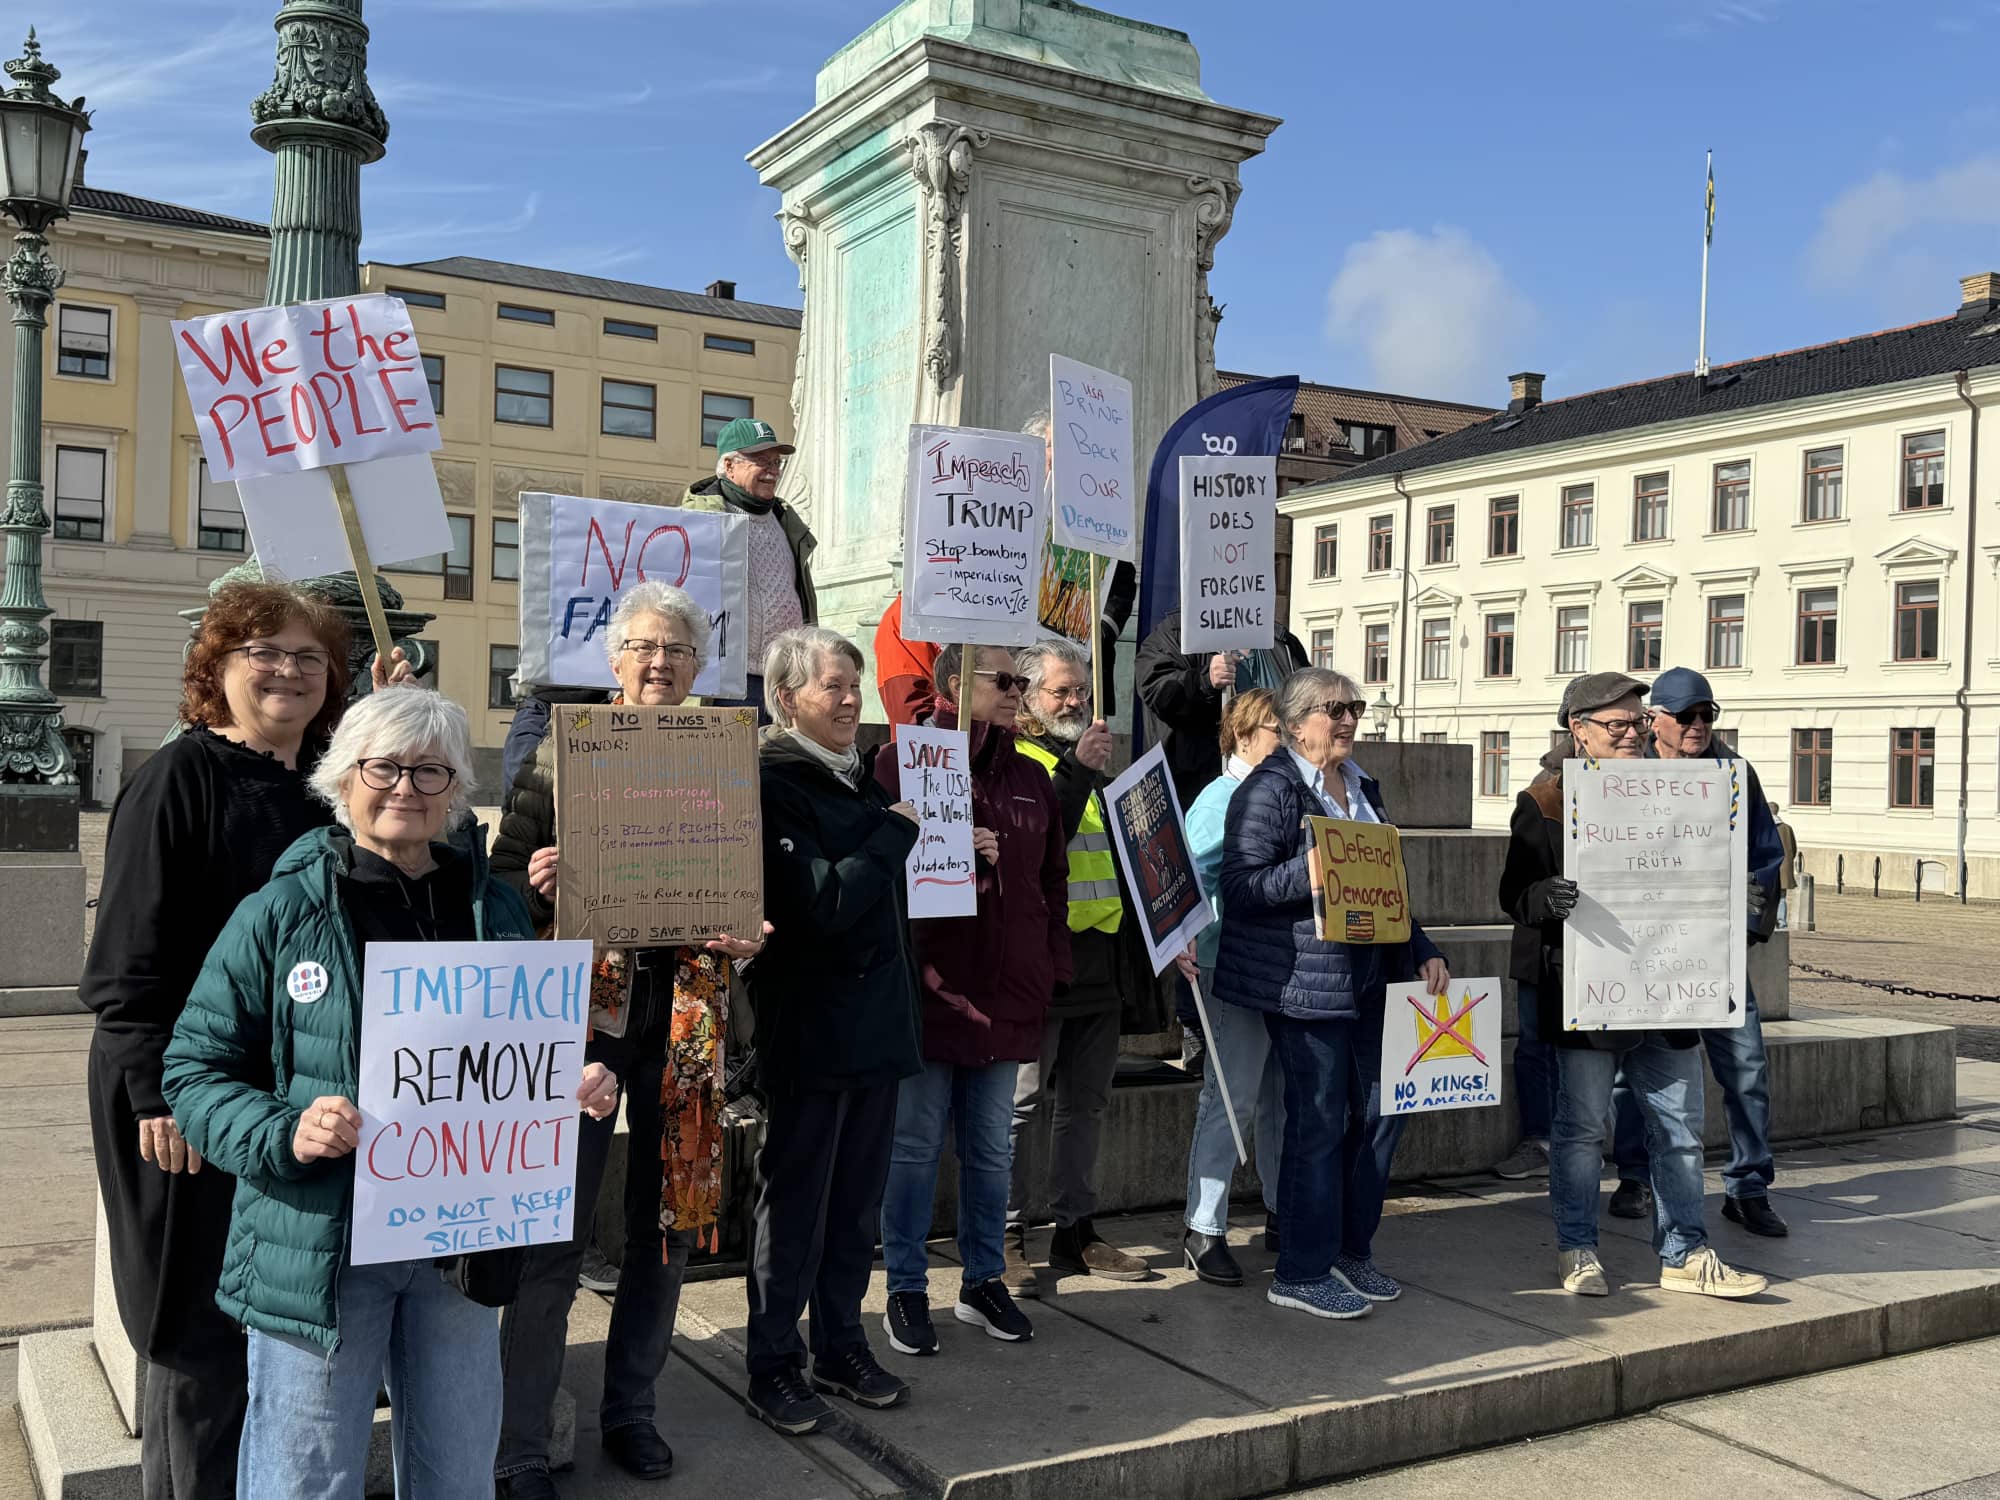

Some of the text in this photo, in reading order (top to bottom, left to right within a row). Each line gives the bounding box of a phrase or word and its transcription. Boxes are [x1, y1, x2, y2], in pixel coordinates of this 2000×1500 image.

[181, 304, 416, 387] We the
[1058, 380, 1124, 424] BRING
[1082, 382, 1105, 403] USA
[209, 368, 433, 470] PEOPLE
[1079, 473, 1121, 500] OUR
[1193, 473, 1266, 498] HISTORY
[935, 492, 1033, 532] TRUMP
[1210, 511, 1253, 529] DOES
[581, 517, 691, 592] NO
[925, 539, 967, 564] Stop
[1213, 542, 1248, 564] NOT
[1200, 574, 1265, 598] FORGIVE
[1199, 607, 1263, 630] SILENCE
[612, 712, 638, 725] NO
[569, 737, 629, 753] HONOR:
[904, 739, 958, 770] SAVE
[591, 788, 610, 800] US
[946, 773, 970, 798] USA
[1120, 769, 1160, 814] DEMOCRACY
[1603, 775, 1715, 800] RESPECT
[921, 801, 938, 820] the
[1124, 804, 1142, 825] DOES
[1151, 784, 1164, 803] FEAR
[1640, 803, 1672, 816] the
[590, 824, 609, 836] US
[620, 823, 655, 836] BILL
[679, 822, 726, 834] RIGHTS
[1127, 795, 1168, 841] PROTESTS
[920, 827, 946, 856] from
[1586, 823, 1712, 843] RULE of LAW
[1625, 856, 1682, 870] TRUTH
[1640, 847, 1665, 857] and
[913, 855, 970, 874] dictators
[584, 893, 626, 909] Follow
[632, 890, 648, 900] the
[654, 887, 682, 899] Rule
[688, 889, 703, 899] of
[1152, 872, 1187, 912] DICTATORS DO
[1643, 891, 1665, 901] at
[608, 926, 638, 940] GOD
[650, 927, 685, 938] SAVE
[1632, 924, 1688, 937] HOME
[1652, 945, 1677, 955] and
[1630, 958, 1708, 975] ABROAD
[380, 962, 584, 1024] IMPEACH
[1587, 981, 1719, 1005] NO KINGS
[1659, 1004, 1695, 1015] USA
[392, 1041, 576, 1105] REMOVE
[1395, 1072, 1489, 1101] NO KINGS!
[1396, 1093, 1496, 1112] IN AMERICA
[368, 1116, 574, 1181] CONVICT
[386, 1185, 571, 1226] DO NOT KEEP
